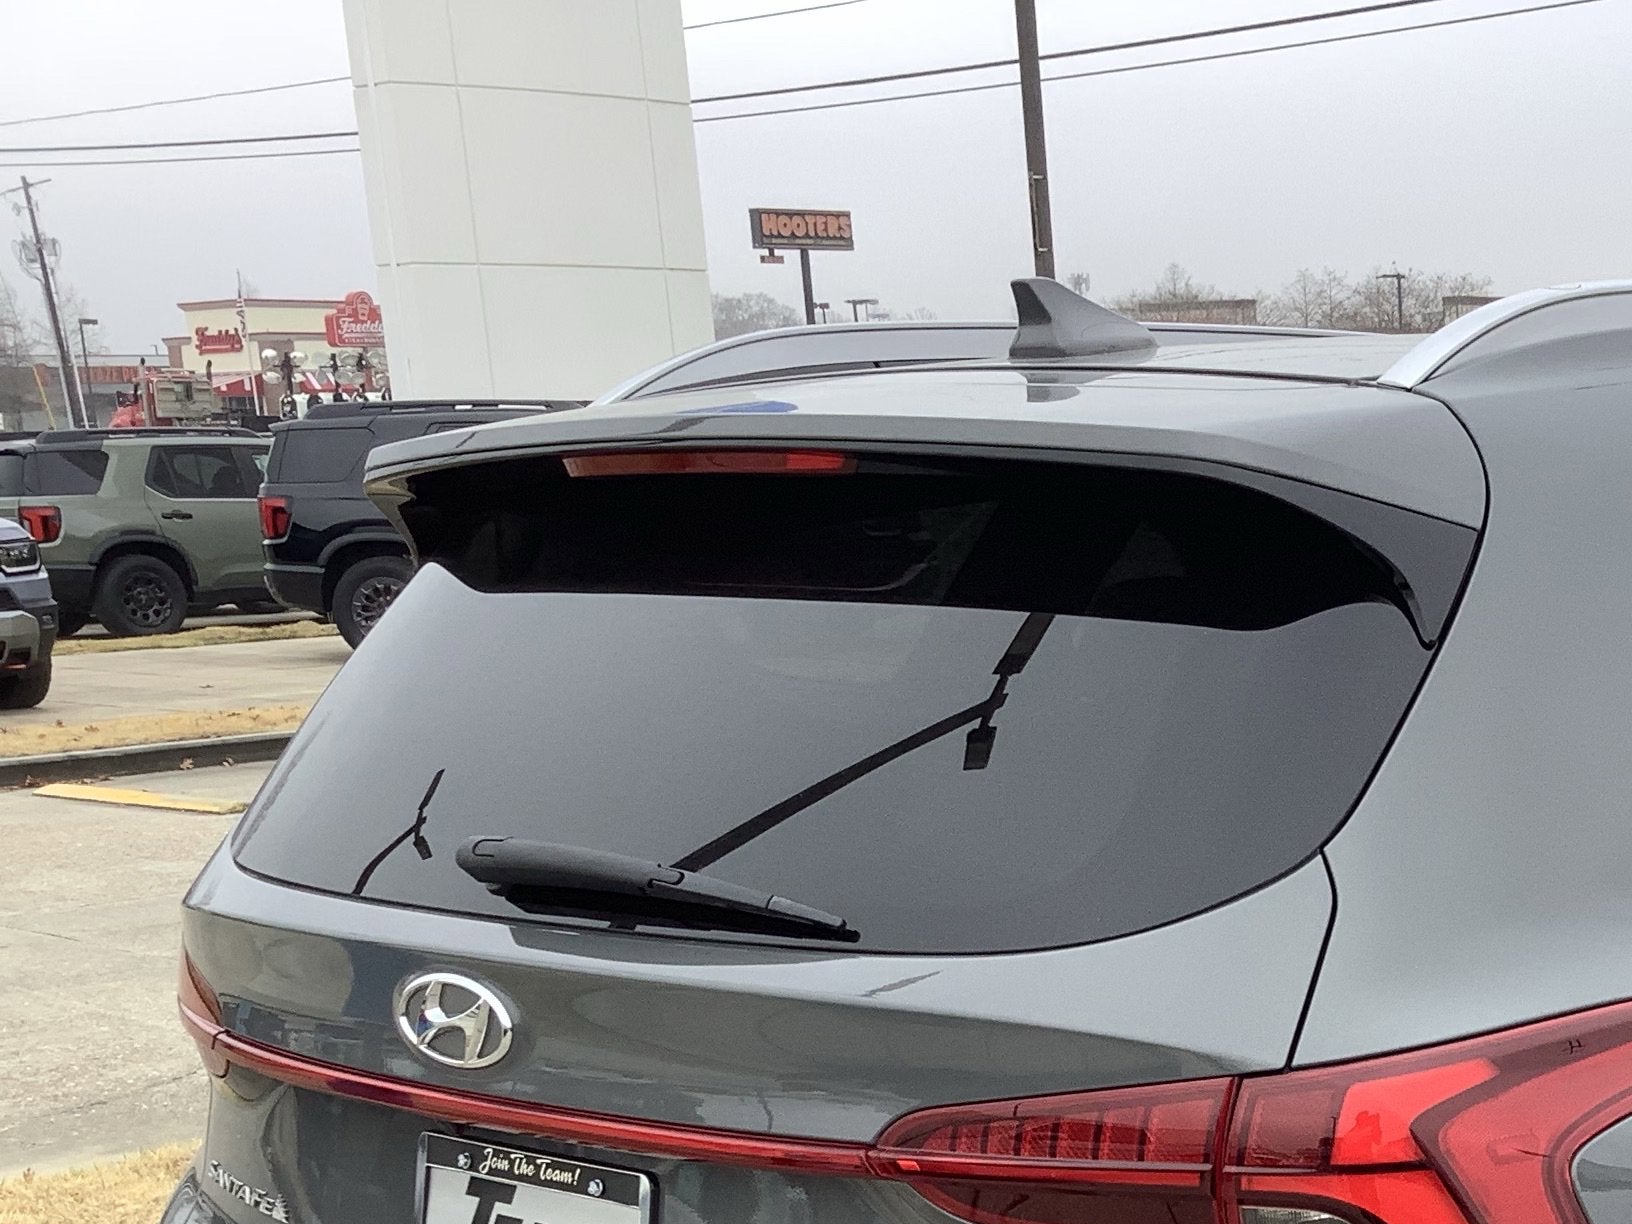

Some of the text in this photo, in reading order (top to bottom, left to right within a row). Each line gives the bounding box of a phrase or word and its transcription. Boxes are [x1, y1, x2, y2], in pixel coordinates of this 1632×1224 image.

[761, 213, 851, 239] HOOTERS
[479, 1148, 581, 1186] Join The Team!
